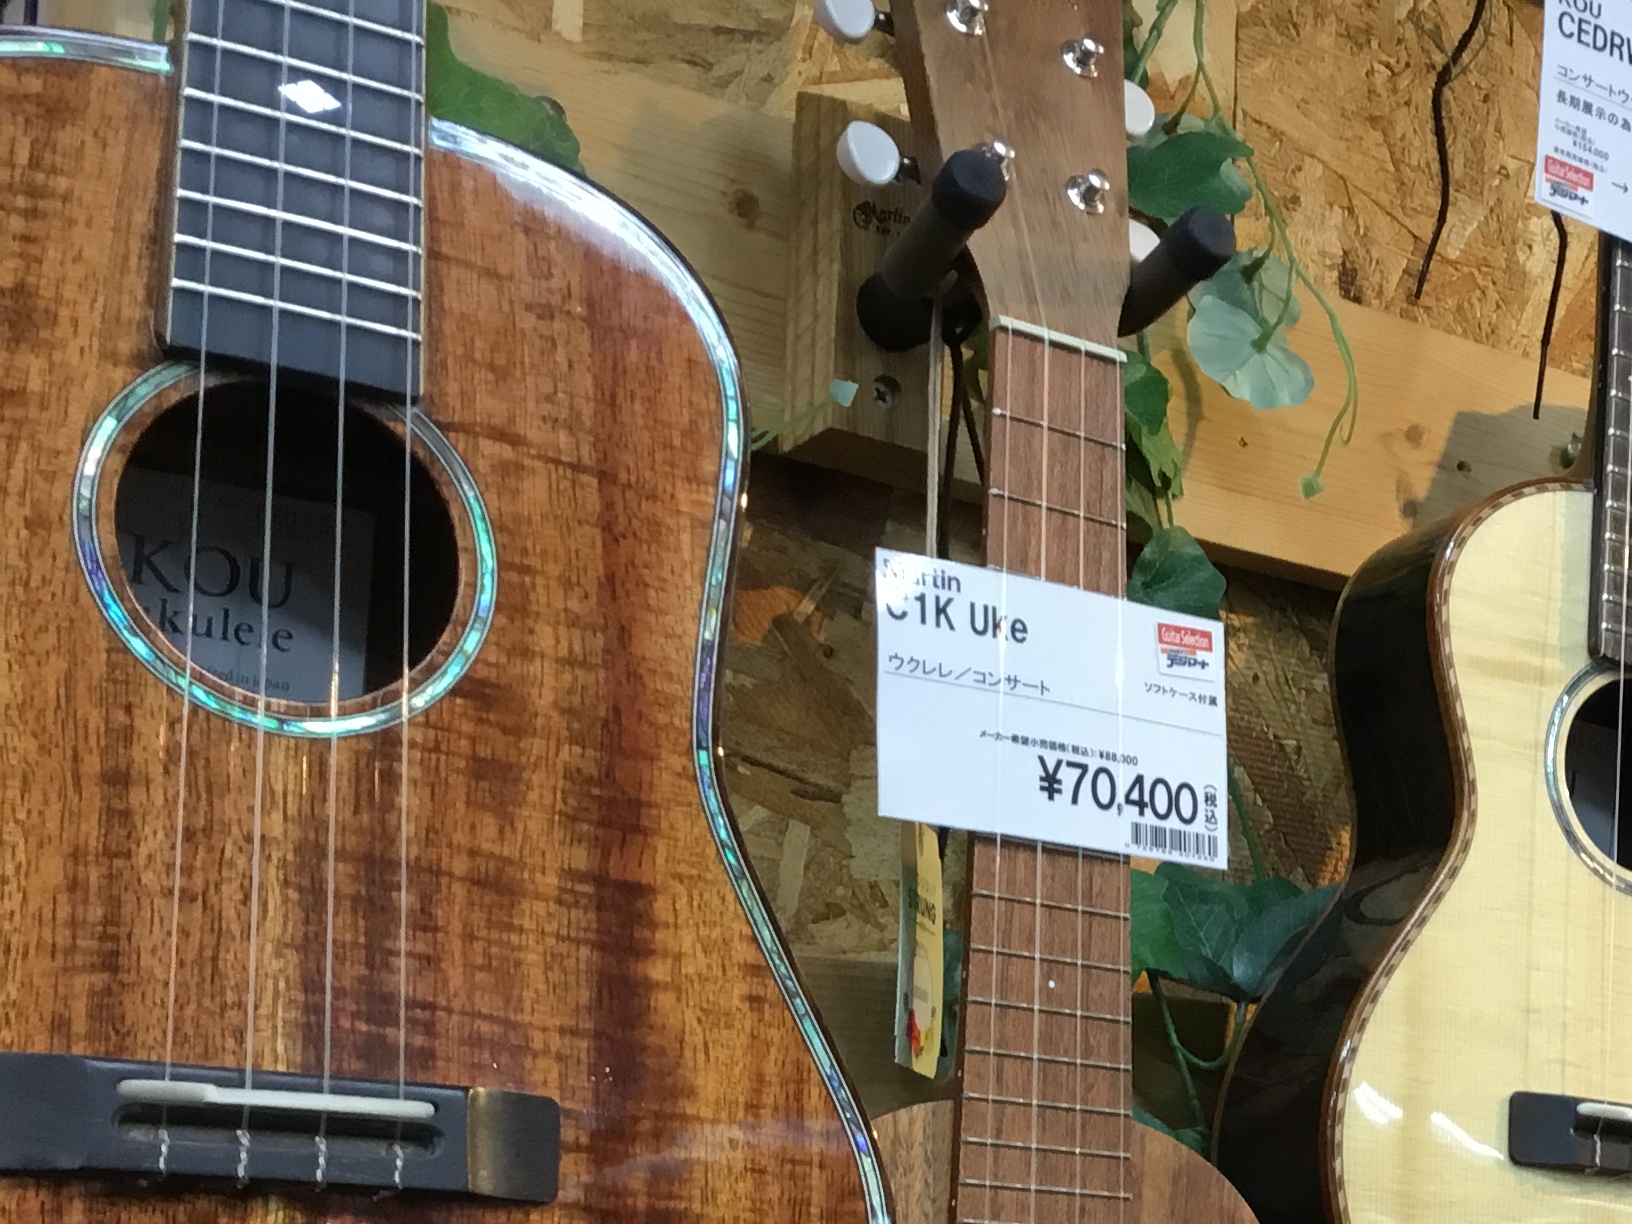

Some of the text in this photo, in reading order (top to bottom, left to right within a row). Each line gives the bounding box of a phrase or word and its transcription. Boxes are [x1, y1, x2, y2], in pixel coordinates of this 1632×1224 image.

[131, 534, 294, 609] KOU
[969, 601, 1029, 644] Uke
[1037, 754, 1199, 825] ¥70,400
